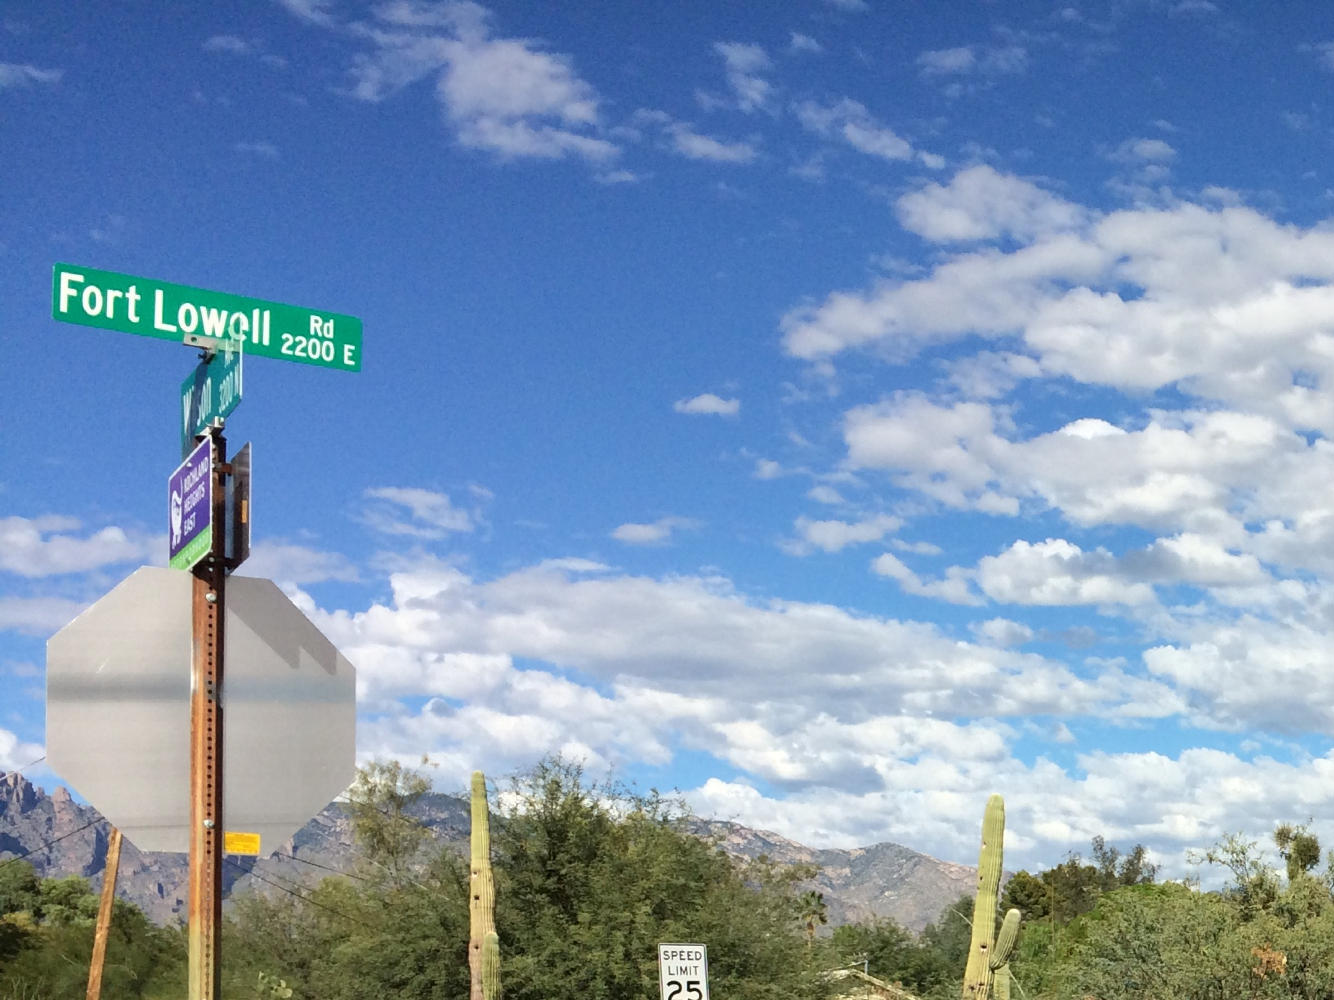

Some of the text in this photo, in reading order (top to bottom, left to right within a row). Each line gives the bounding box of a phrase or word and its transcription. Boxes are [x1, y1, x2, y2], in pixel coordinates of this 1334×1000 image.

[59, 271, 271, 346] Fort Lowell
[309, 314, 335, 339] Rd
[280, 333, 356, 366] 2200 E
[663, 950, 702, 961] SPEED
[667, 965, 699, 976] LIMIT
